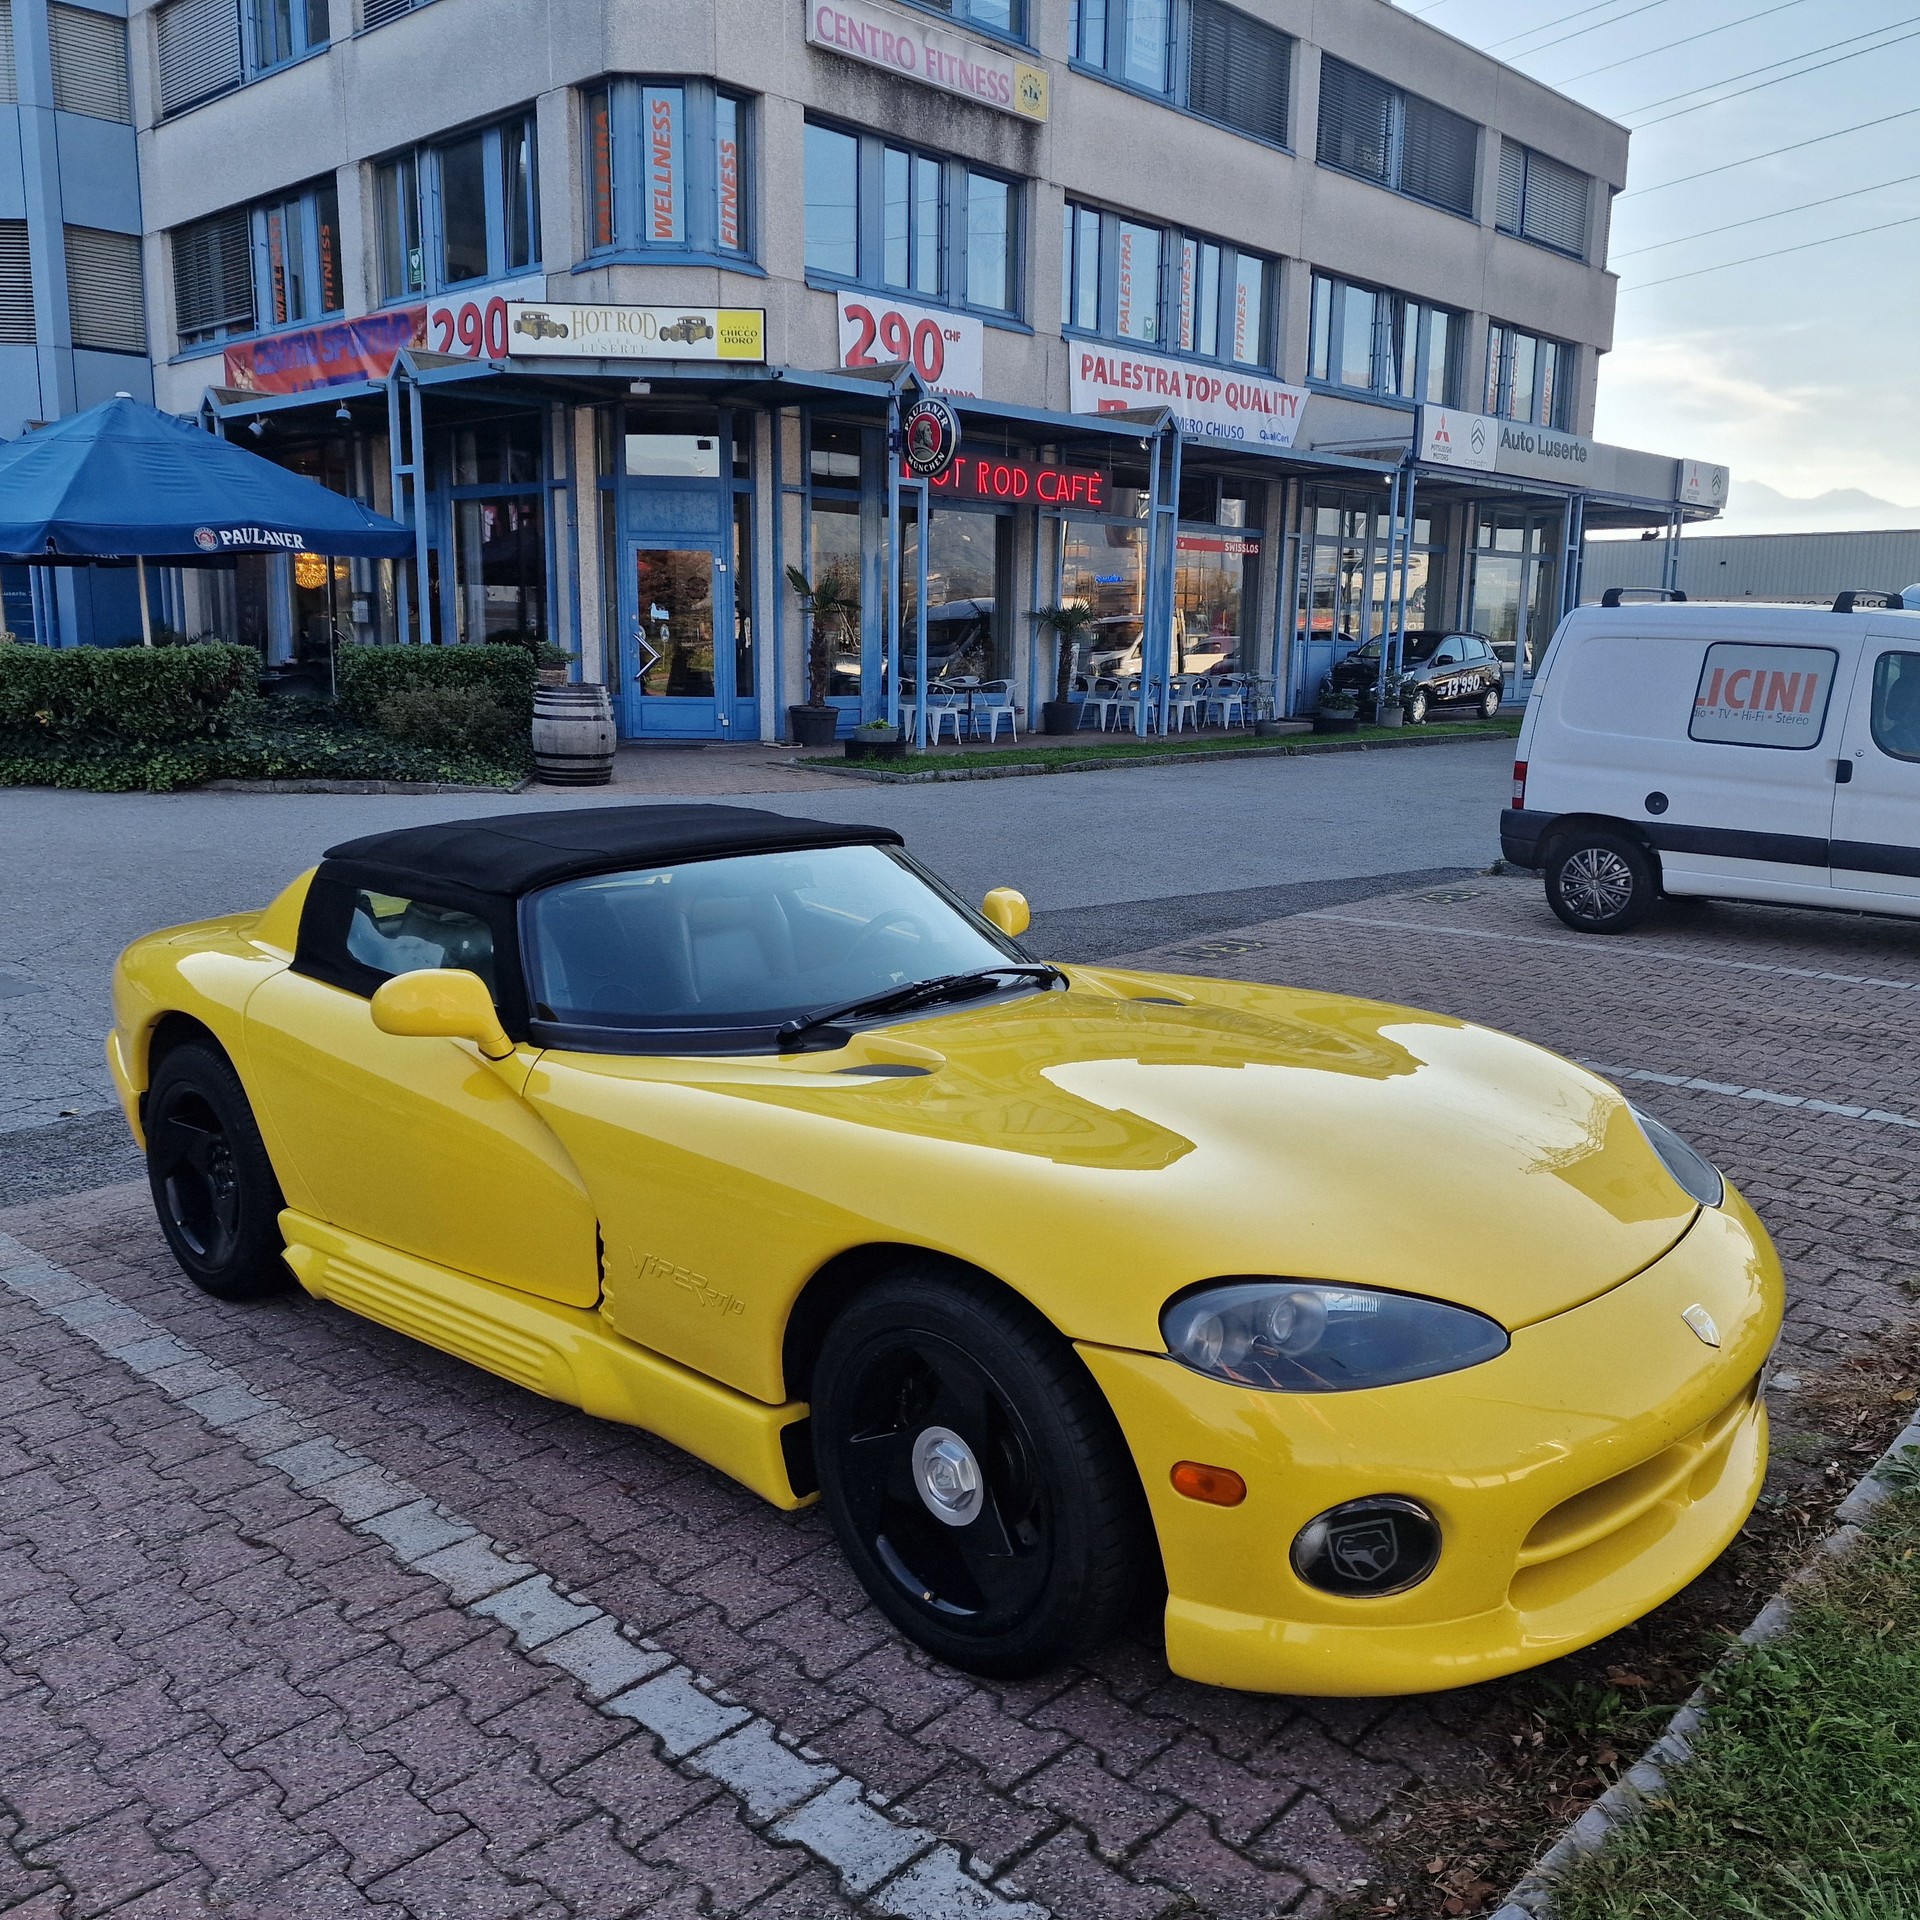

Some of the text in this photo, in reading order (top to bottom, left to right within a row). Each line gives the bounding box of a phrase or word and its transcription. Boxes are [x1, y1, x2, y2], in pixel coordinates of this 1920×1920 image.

[816, 5, 916, 70] CENTRO
[924, 46, 1010, 104] FITNESS
[652, 98, 672, 238] WELLNESS
[719, 139, 737, 246] FITNESS
[320, 224, 334, 310] FITNESS
[1119, 233, 1132, 334] PALESTRA
[1180, 246, 1192, 348] WELLNESS
[432, 296, 509, 360] 290
[571, 309, 658, 342] HOT ROD
[720, 329, 758, 337] CHICCO
[1234, 283, 1247, 359] FITNESS
[581, 343, 649, 355] LUSERTE
[724, 336, 754, 344] D'ORO
[844, 304, 962, 383] 290 CHF
[1081, 353, 1299, 419] PALESTRA TOP QUALITY
[904, 402, 949, 431] PAULANER
[1205, 421, 1245, 440] CHIUSO
[1259, 429, 1290, 444] QualiCert
[1500, 427, 1588, 463] Auto Luserte
[908, 452, 945, 472] MÜNCHEN
[977, 461, 1029, 497] ROD
[1036, 471, 1103, 505] CAFÈ
[219, 527, 306, 550] PAULANER
[1224, 542, 1259, 554] SWISSLOS
[1447, 674, 1481, 696] 13'990
[1718, 708, 1731, 719] TV
[1741, 710, 1765, 722] Hi-Fi
